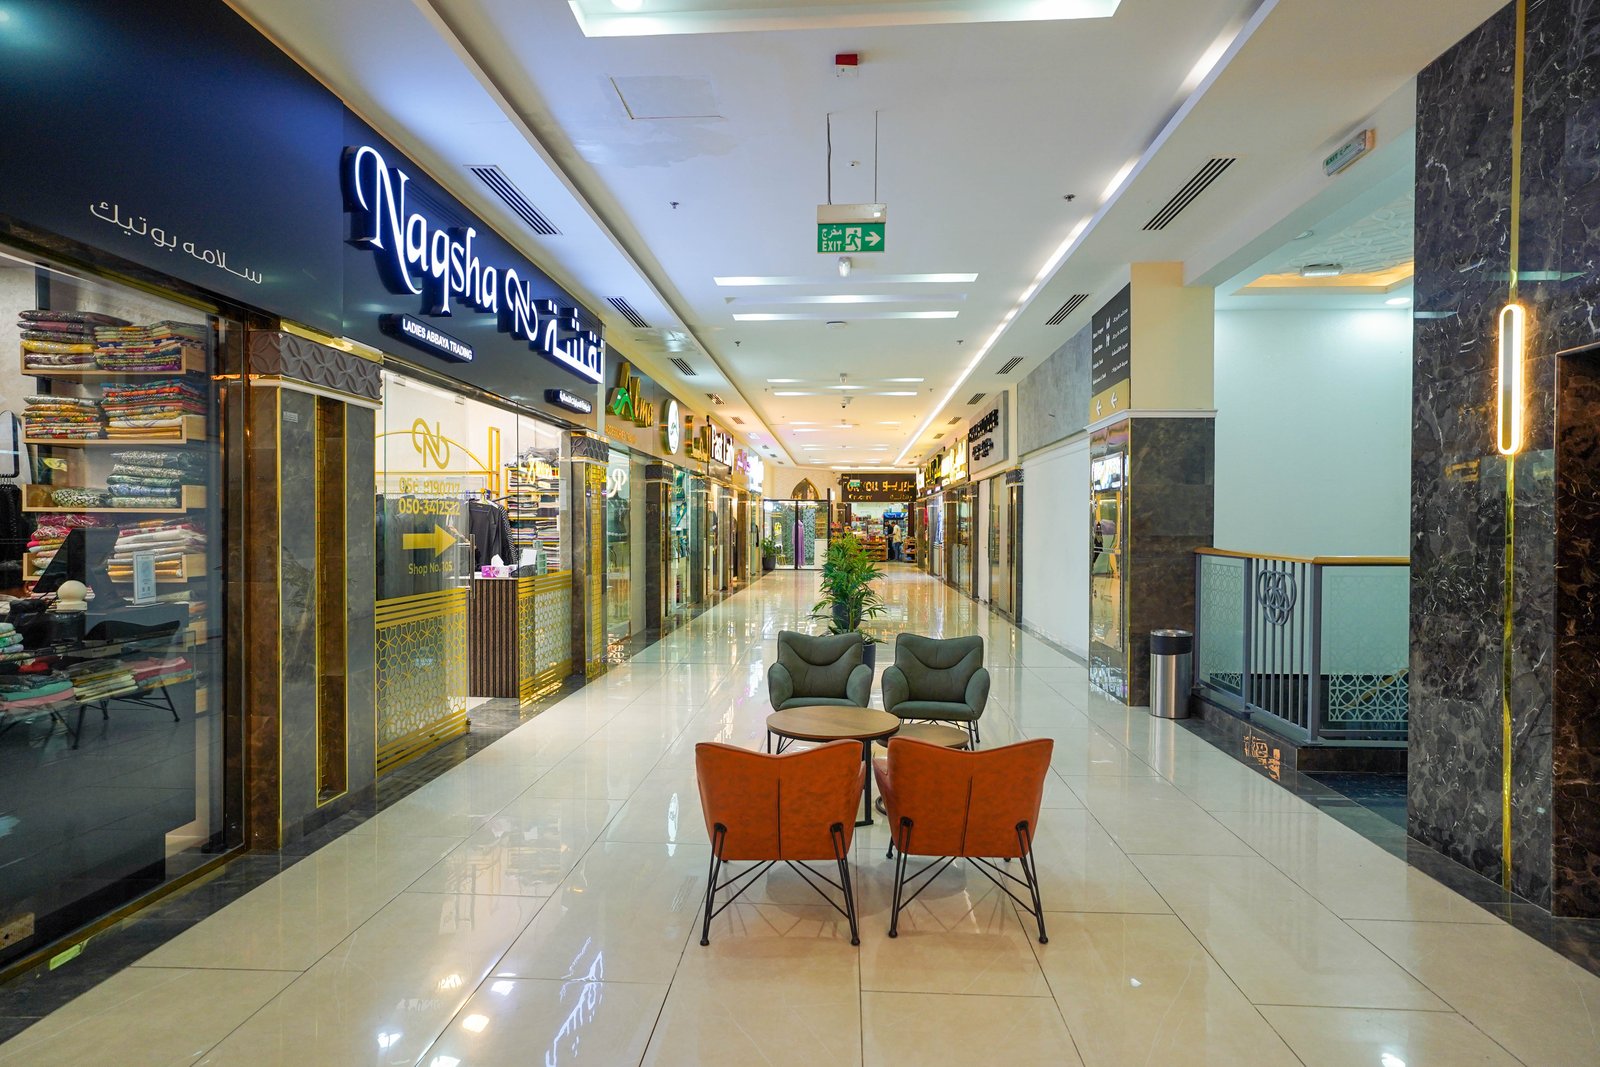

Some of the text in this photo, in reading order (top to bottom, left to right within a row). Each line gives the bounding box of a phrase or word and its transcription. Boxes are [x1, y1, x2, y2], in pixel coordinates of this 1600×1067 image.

[90, 201, 177, 251] بوتيك
[355, 146, 498, 314] Naqsha
[822, 241, 842, 251] EXIT
[402, 318, 473, 361] LADIES ABBAYA TRADING
[545, 299, 604, 384] نقشة
[408, 563, 427, 576] Shop
